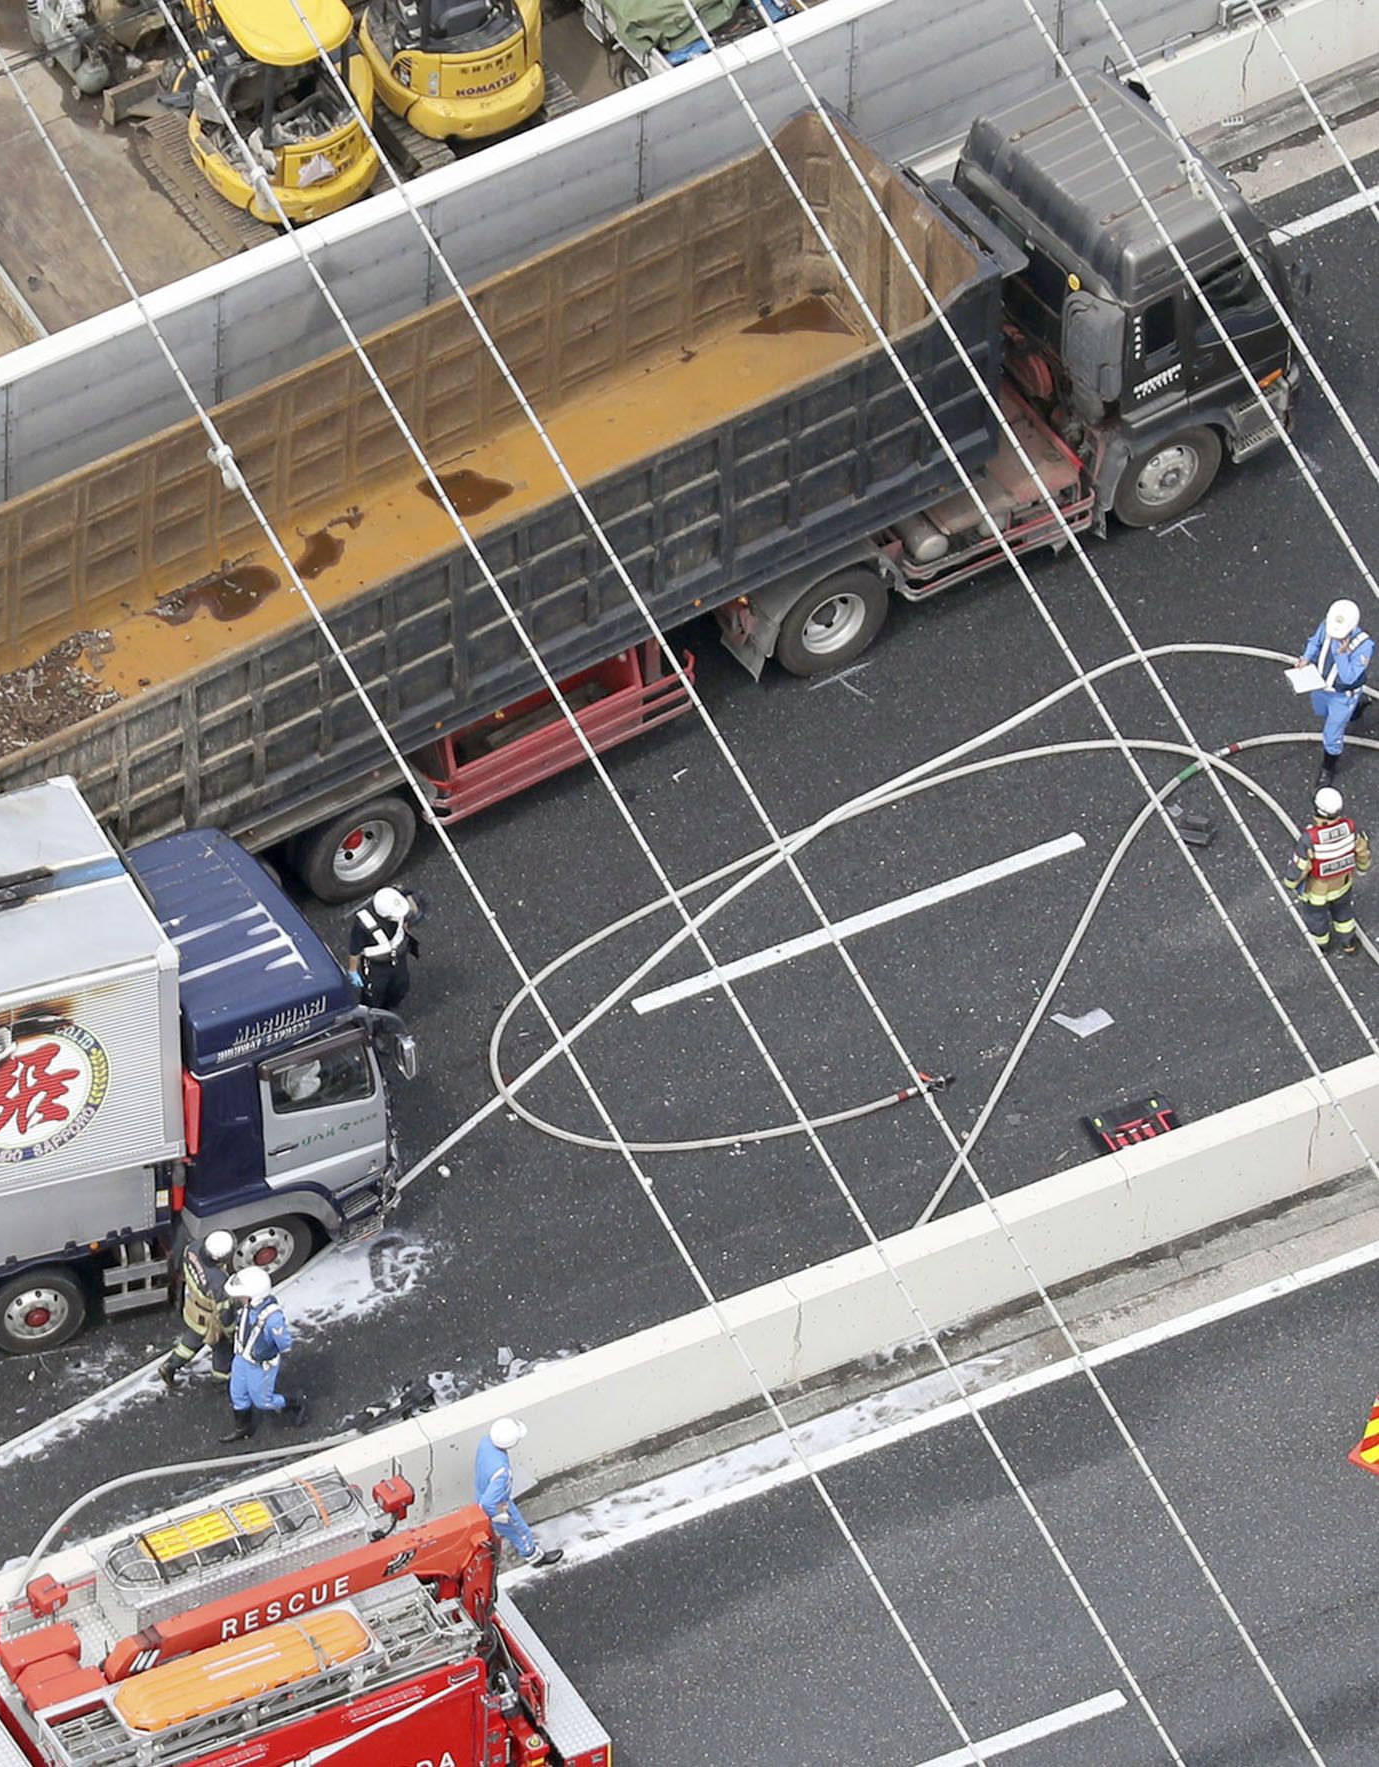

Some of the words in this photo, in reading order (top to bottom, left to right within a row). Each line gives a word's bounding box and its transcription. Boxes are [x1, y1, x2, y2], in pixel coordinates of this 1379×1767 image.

[456, 71, 517, 97] KOMATSU
[216, 1037, 262, 1064] HIGHWAY
[266, 1019, 311, 1046] EXPRESS
[232, 995, 327, 1046] MARUHARI
[32, 1106, 96, 1158] SAPPORO
[221, 1575, 350, 1639] RESCUE
